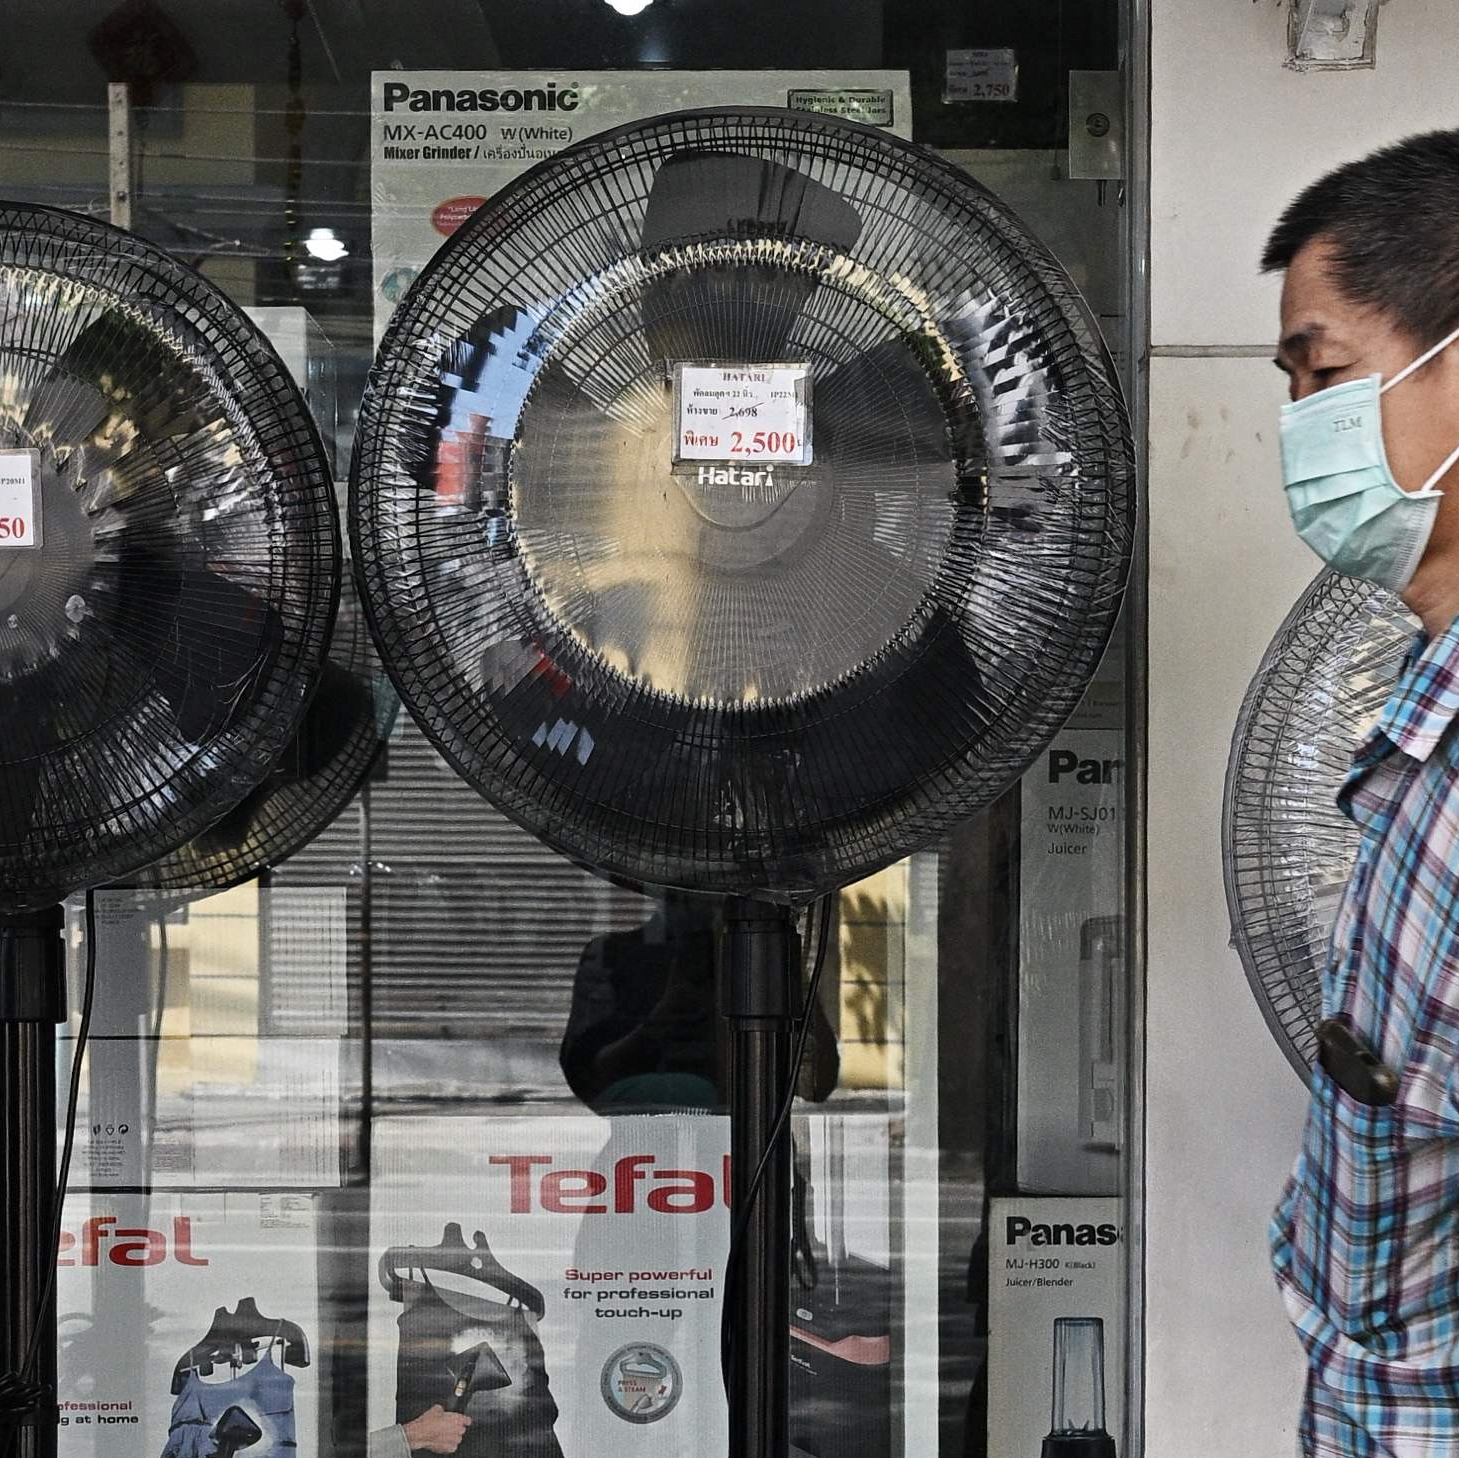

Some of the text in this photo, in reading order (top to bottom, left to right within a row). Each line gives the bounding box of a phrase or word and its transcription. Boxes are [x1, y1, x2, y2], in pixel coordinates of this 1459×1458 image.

[383, 82, 579, 112] Panasonic
[383, 124, 487, 140] MX-AC400
[383, 146, 419, 160] Mixer
[422, 145, 472, 160] Grinder
[722, 372, 766, 382] HATARI
[729, 406, 758, 418] 2,698
[1333, 416, 1363, 432] TLM
[684, 430, 796, 457] พิเศษ 2,500
[697, 463, 774, 487] Hatari
[1048, 749, 1126, 785] Pan
[1048, 806, 1116, 821] MJ-SJ01
[1047, 842, 1087, 855] Juicer
[1006, 1216, 1124, 1246] Panas
[1005, 1258, 1060, 1269] MJ-H300
[565, 1267, 713, 1284] Super powerful
[1005, 1277, 1073, 1288] Juicer/Blender
[563, 1286, 714, 1302] for professional
[594, 1306, 683, 1320] touch-up
[75, 1414, 92, 1425] at
[98, 1414, 139, 1425] home
